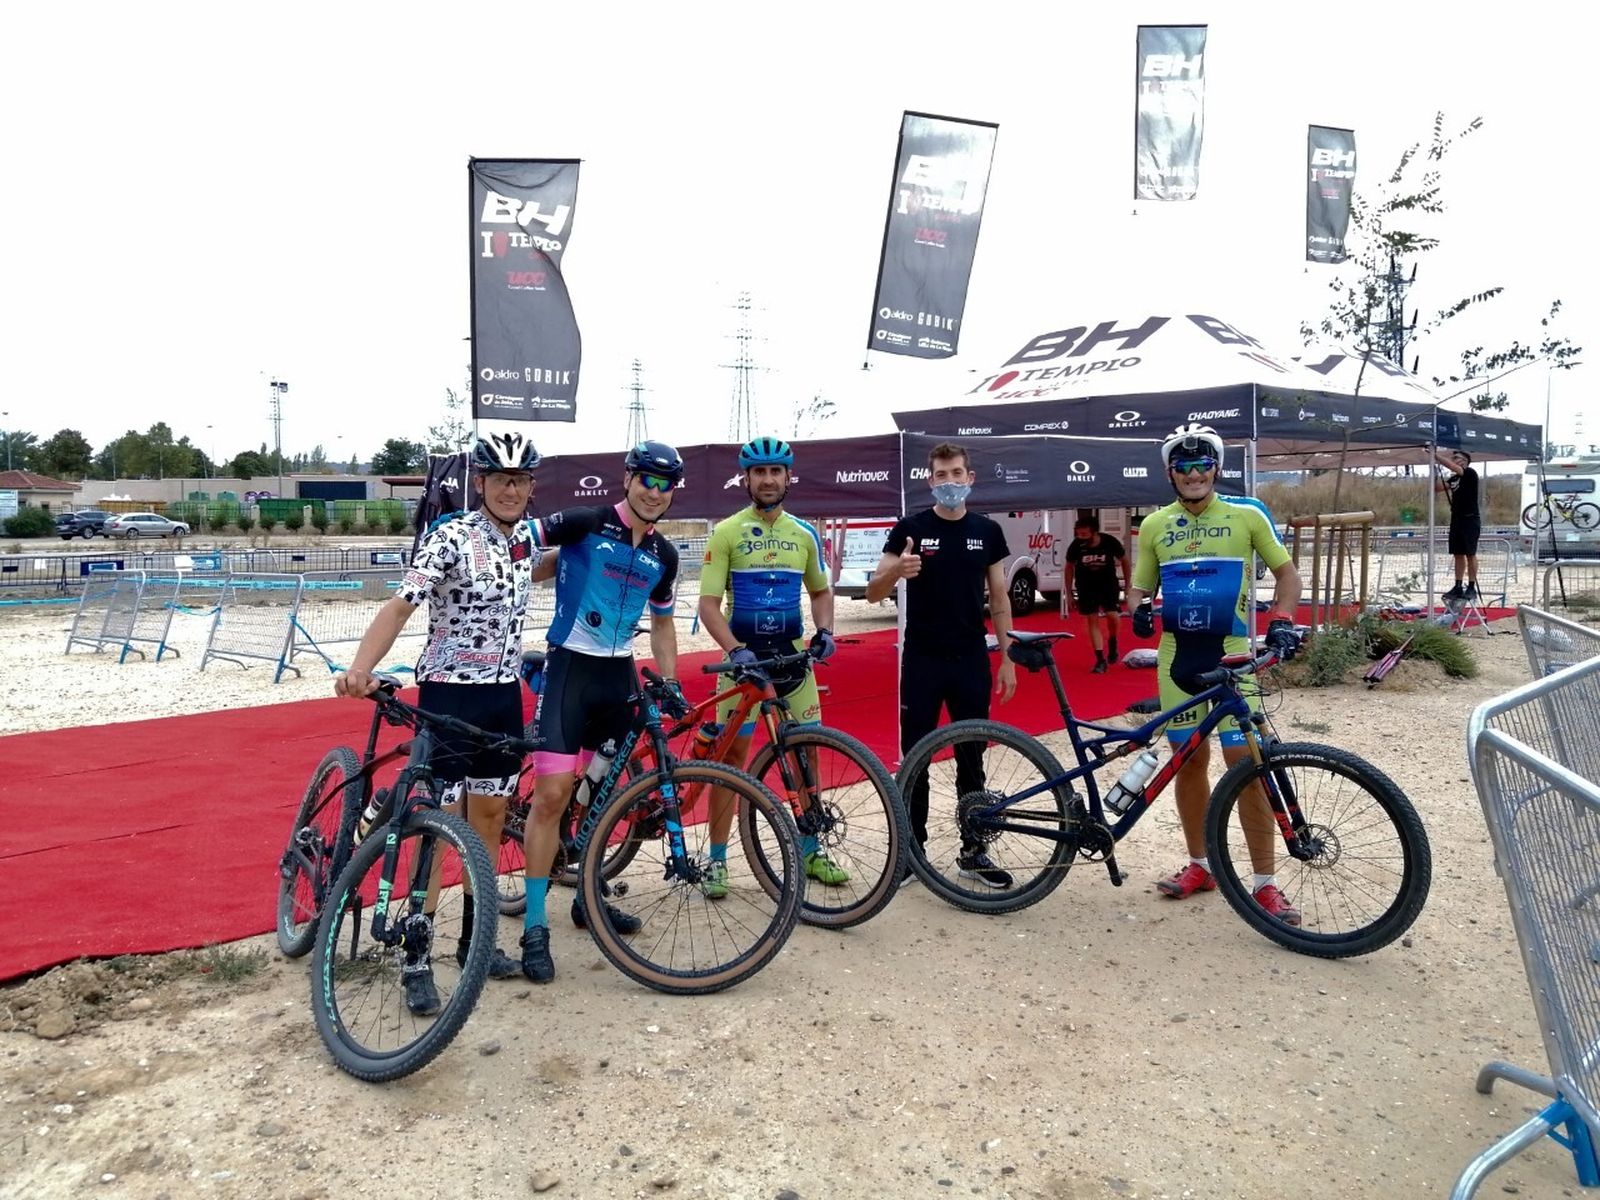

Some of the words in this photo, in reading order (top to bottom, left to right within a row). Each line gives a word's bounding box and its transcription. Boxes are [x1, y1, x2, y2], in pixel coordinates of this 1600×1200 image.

[1312, 148, 1355, 167] BH
[481, 190, 570, 236] BH
[481, 231, 494, 257] I
[918, 312, 954, 331] GOBIK
[1001, 316, 1171, 368] BH
[494, 369, 520, 379] aldro
[525, 367, 570, 384] GOBIK
[1188, 408, 1241, 421] CHAOYANG
[1109, 420, 1147, 428] OAKLEY
[836, 469, 889, 484] Nutrinovex
[1067, 474, 1096, 482] OAKLEY
[574, 489, 609, 497] OAKLEY
[921, 538, 940, 546] BH
[1082, 554, 1106, 563] BH
[1173, 711, 1197, 723] BH
[1288, 753, 1327, 762] PATROL
[574, 731, 637, 850] MONDRAKER
[323, 887, 350, 1021] CROSSMAX
